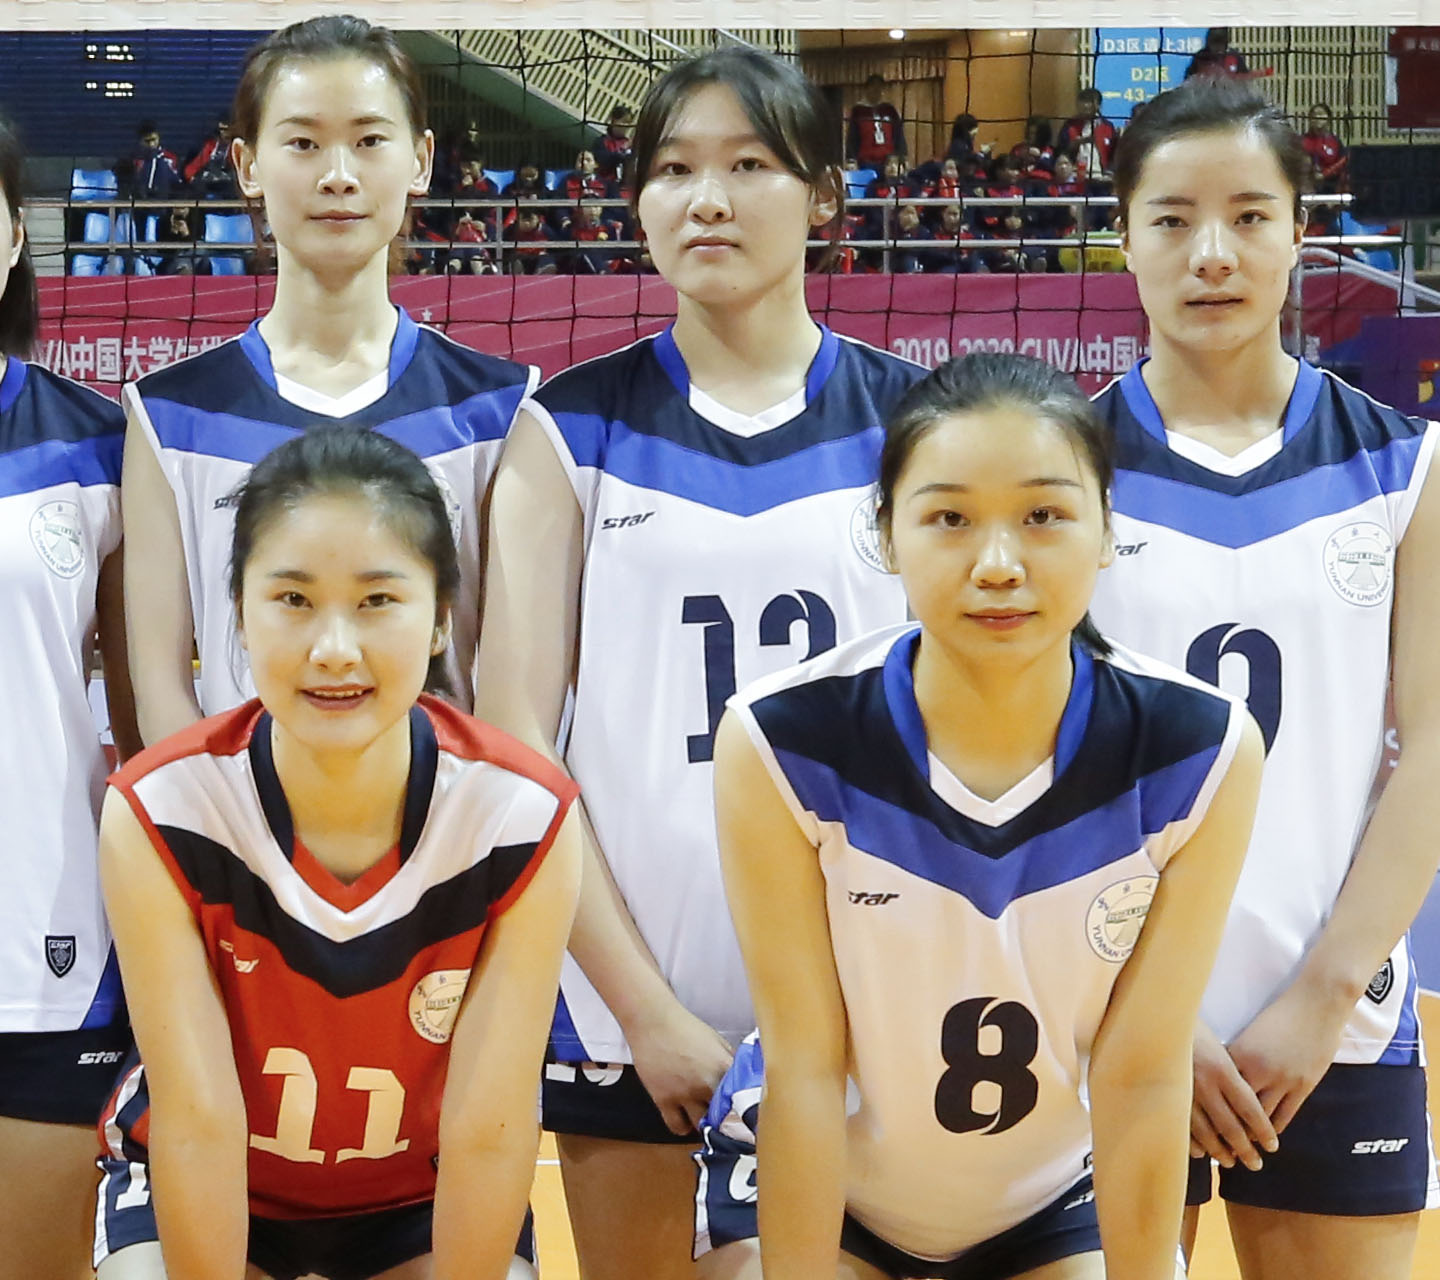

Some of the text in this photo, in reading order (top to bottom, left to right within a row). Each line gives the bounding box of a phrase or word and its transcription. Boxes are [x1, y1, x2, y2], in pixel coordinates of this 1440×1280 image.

[601, 510, 656, 530] star
[934, 996, 1039, 1136] 8
[248, 1047, 410, 1165] 11
[1350, 1137, 1409, 1155] star
